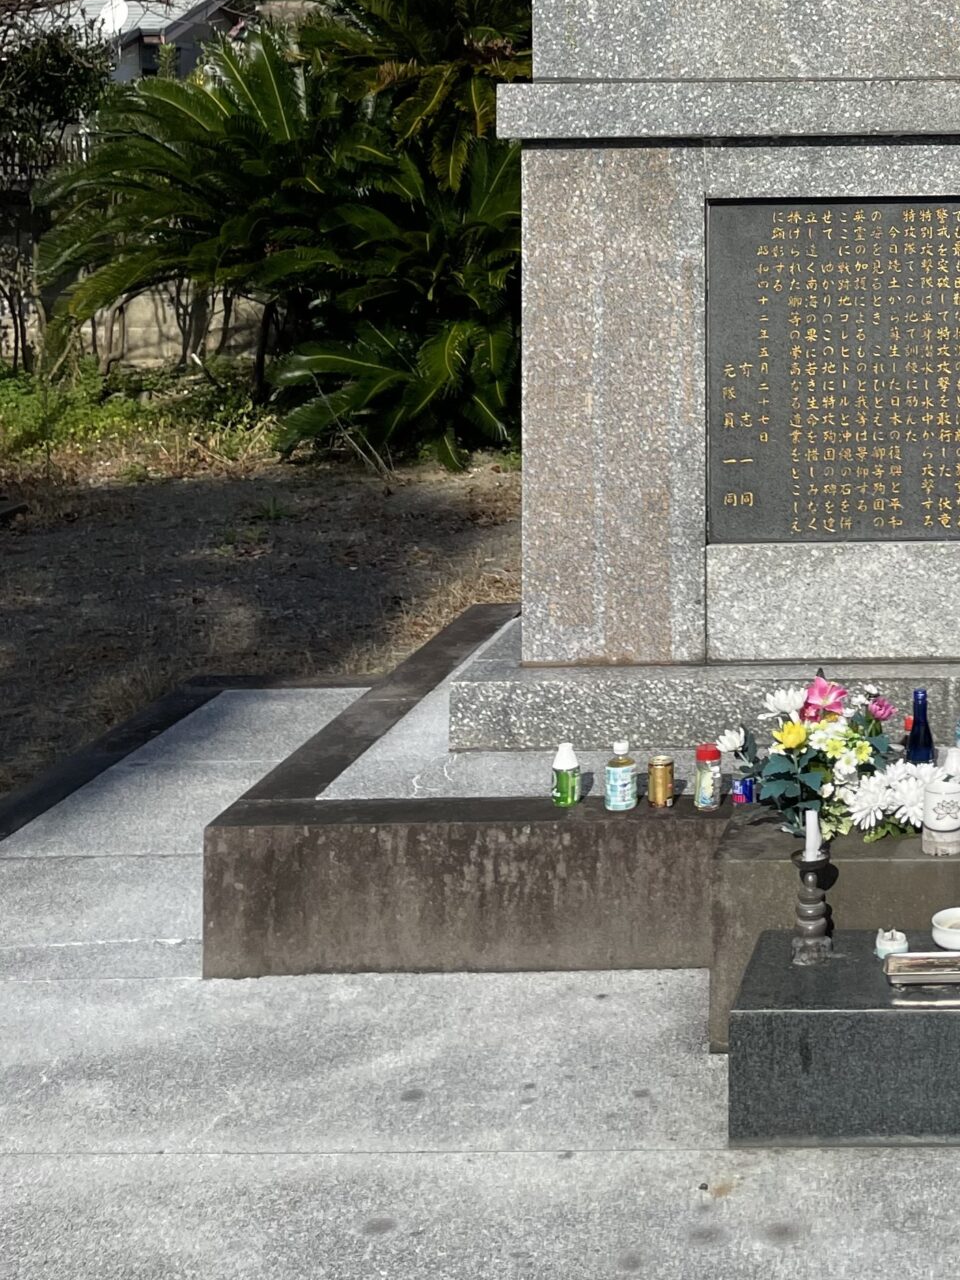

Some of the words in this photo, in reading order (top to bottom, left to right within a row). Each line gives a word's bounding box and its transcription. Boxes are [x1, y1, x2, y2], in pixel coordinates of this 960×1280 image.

[771, 213, 785, 291] に顕彰する
[757, 246, 769, 442] 昭和四十二年五月二十七日
[722, 364, 737, 506] 元隊員一同
